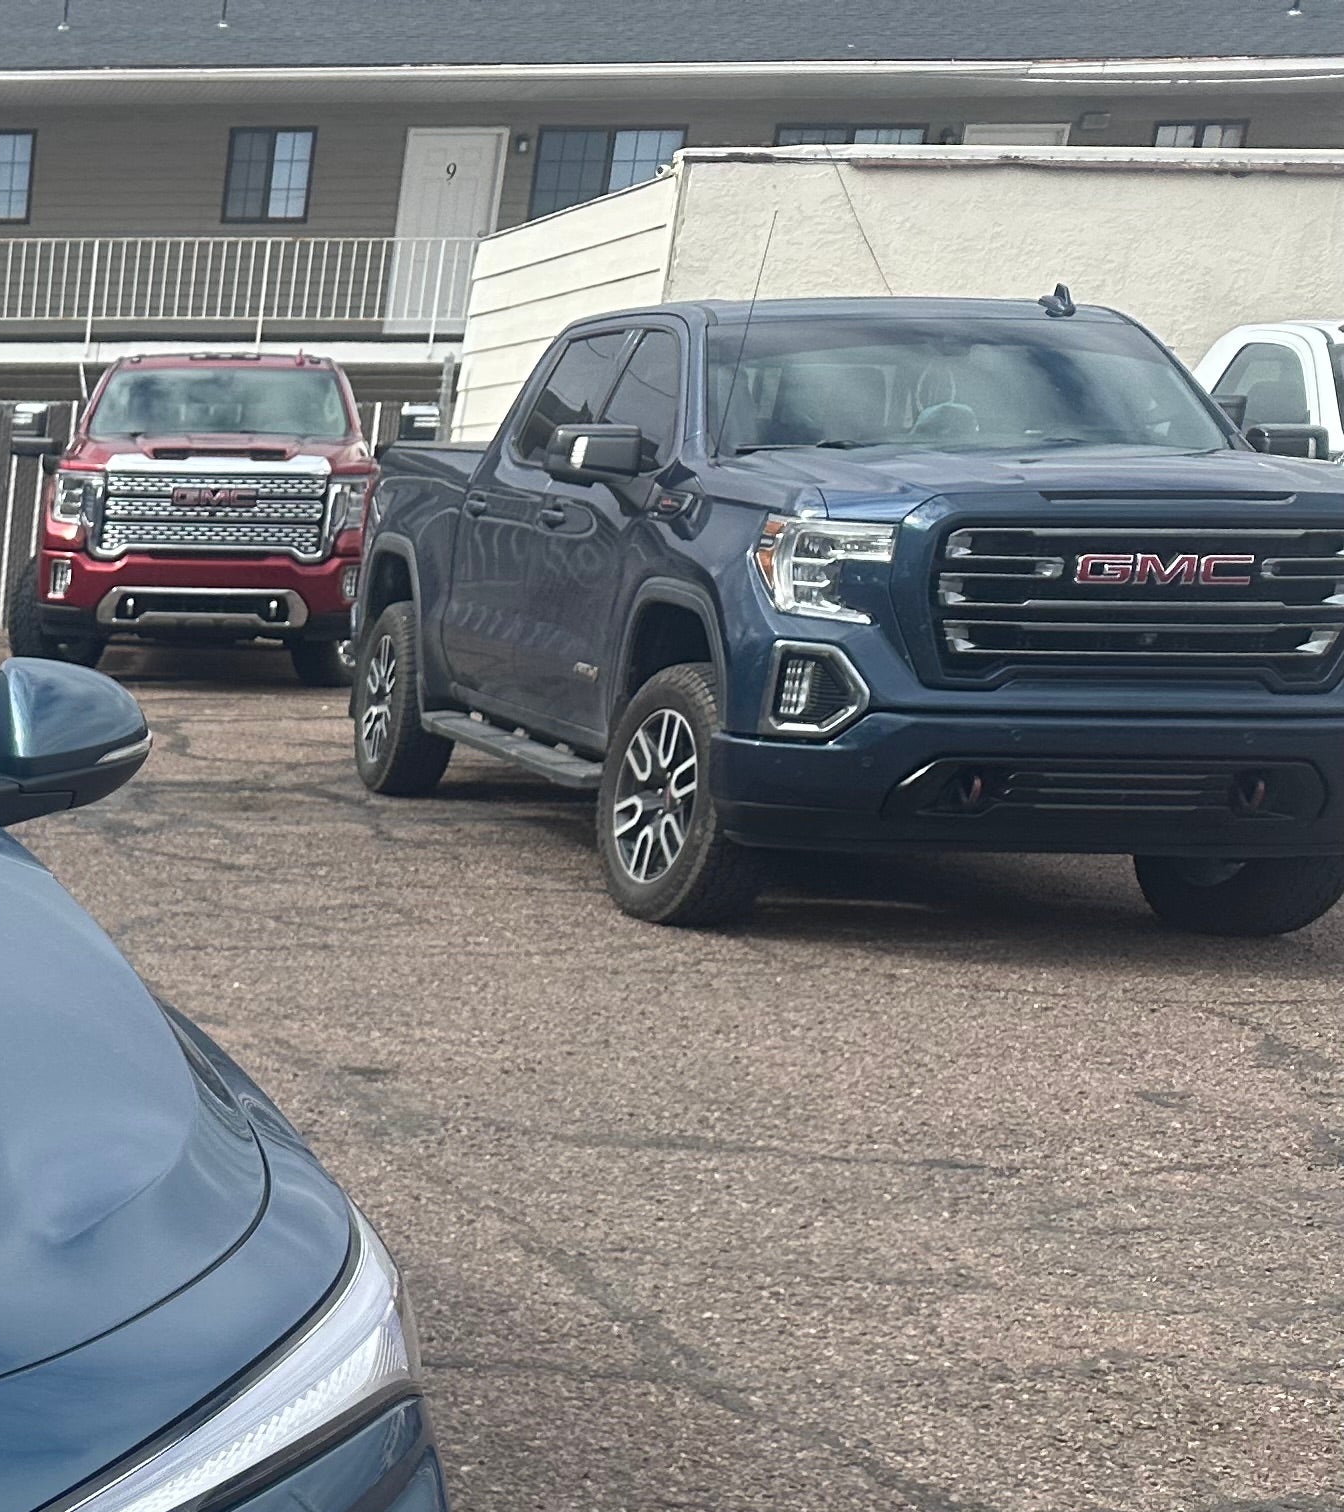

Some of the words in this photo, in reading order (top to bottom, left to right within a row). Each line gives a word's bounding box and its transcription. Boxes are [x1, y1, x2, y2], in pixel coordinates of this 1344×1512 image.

[446, 162, 457, 182] 9
[171, 486, 257, 507] GMC
[1074, 553, 1255, 585] GMC
